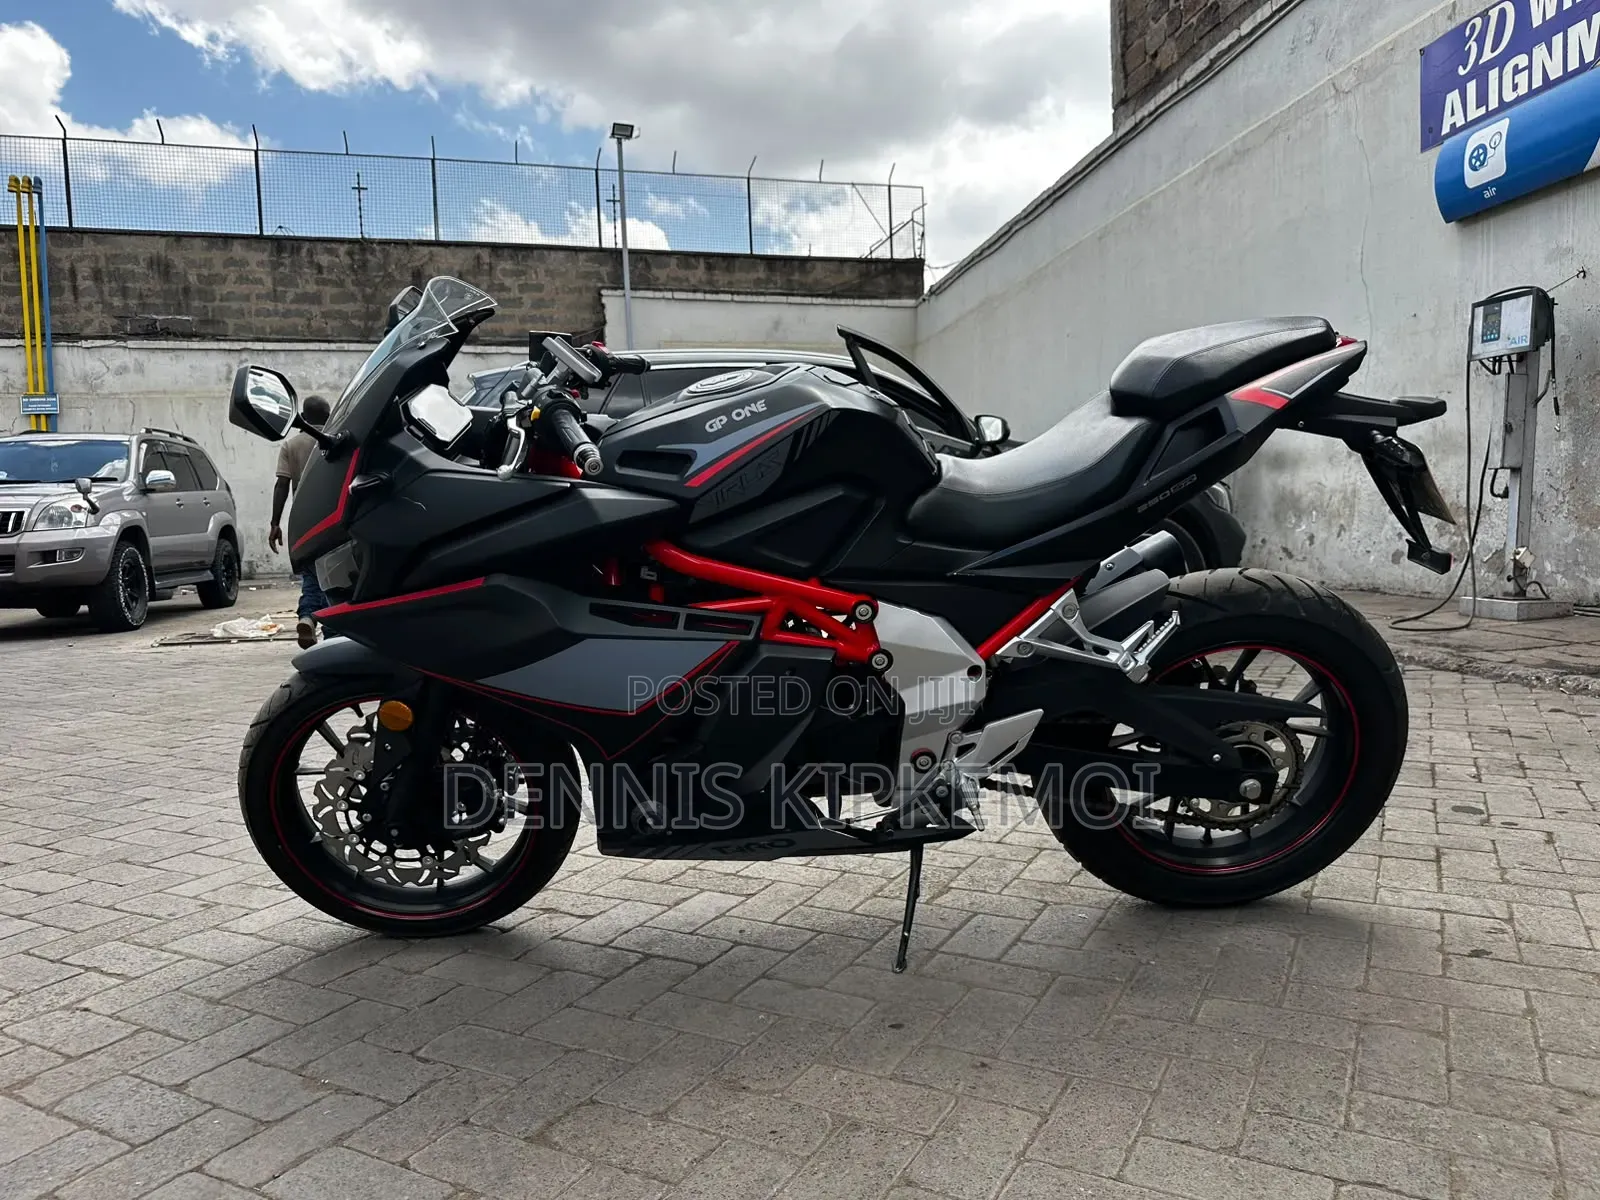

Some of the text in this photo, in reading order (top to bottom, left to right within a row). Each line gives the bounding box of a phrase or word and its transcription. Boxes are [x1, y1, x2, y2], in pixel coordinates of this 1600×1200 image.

[1457, 0, 1515, 76] 3D
[1441, 11, 1600, 136] ALIGNM
[1483, 186, 1497, 199] air
[705, 399, 767, 433] GP ONE
